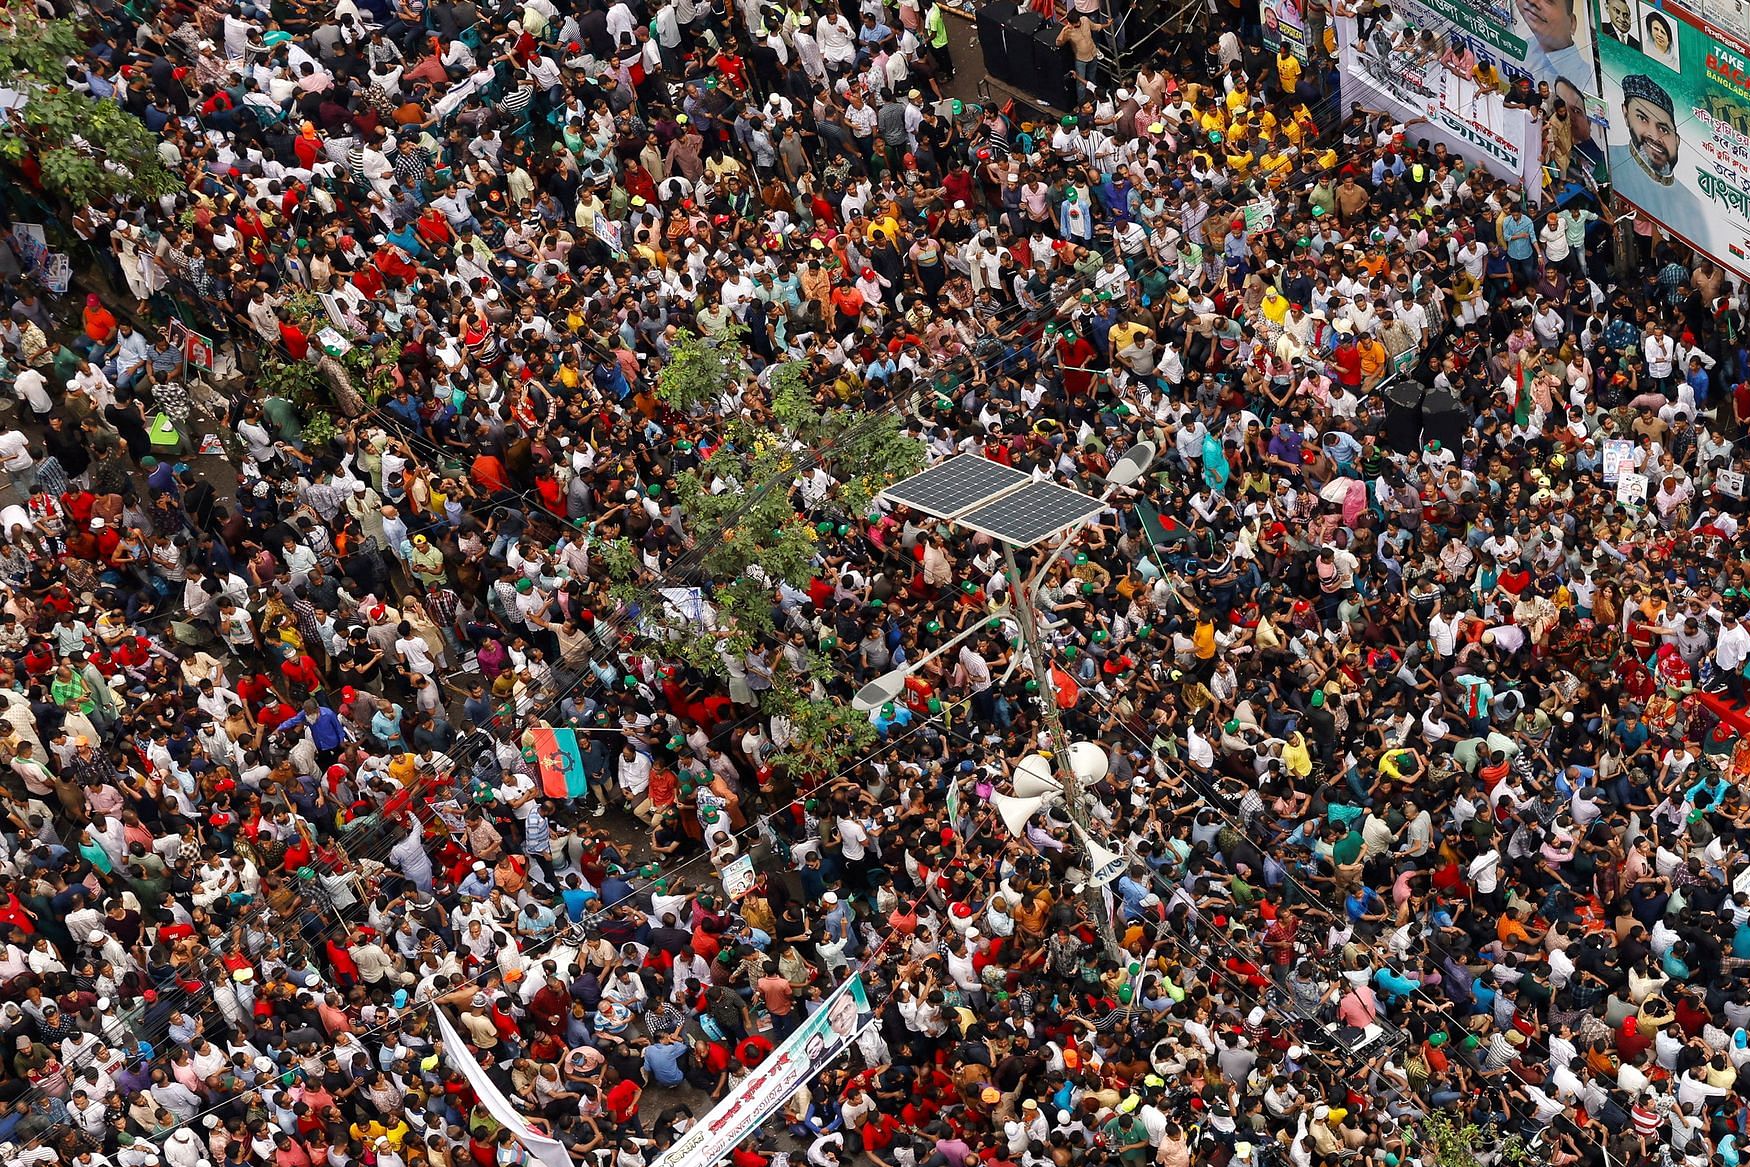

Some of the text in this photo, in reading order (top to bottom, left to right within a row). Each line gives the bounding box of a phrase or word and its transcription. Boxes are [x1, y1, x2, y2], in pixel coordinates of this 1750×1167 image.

[1714, 46, 1744, 71] TAKE
[1692, 106, 1711, 124] যদি
[1712, 115, 1732, 140] তুমি
[1734, 129, 1749, 146] ভয়
[1712, 132, 1728, 149] তবে
[1731, 142, 1748, 159] তুমি
[1713, 161, 1736, 183] তবে
